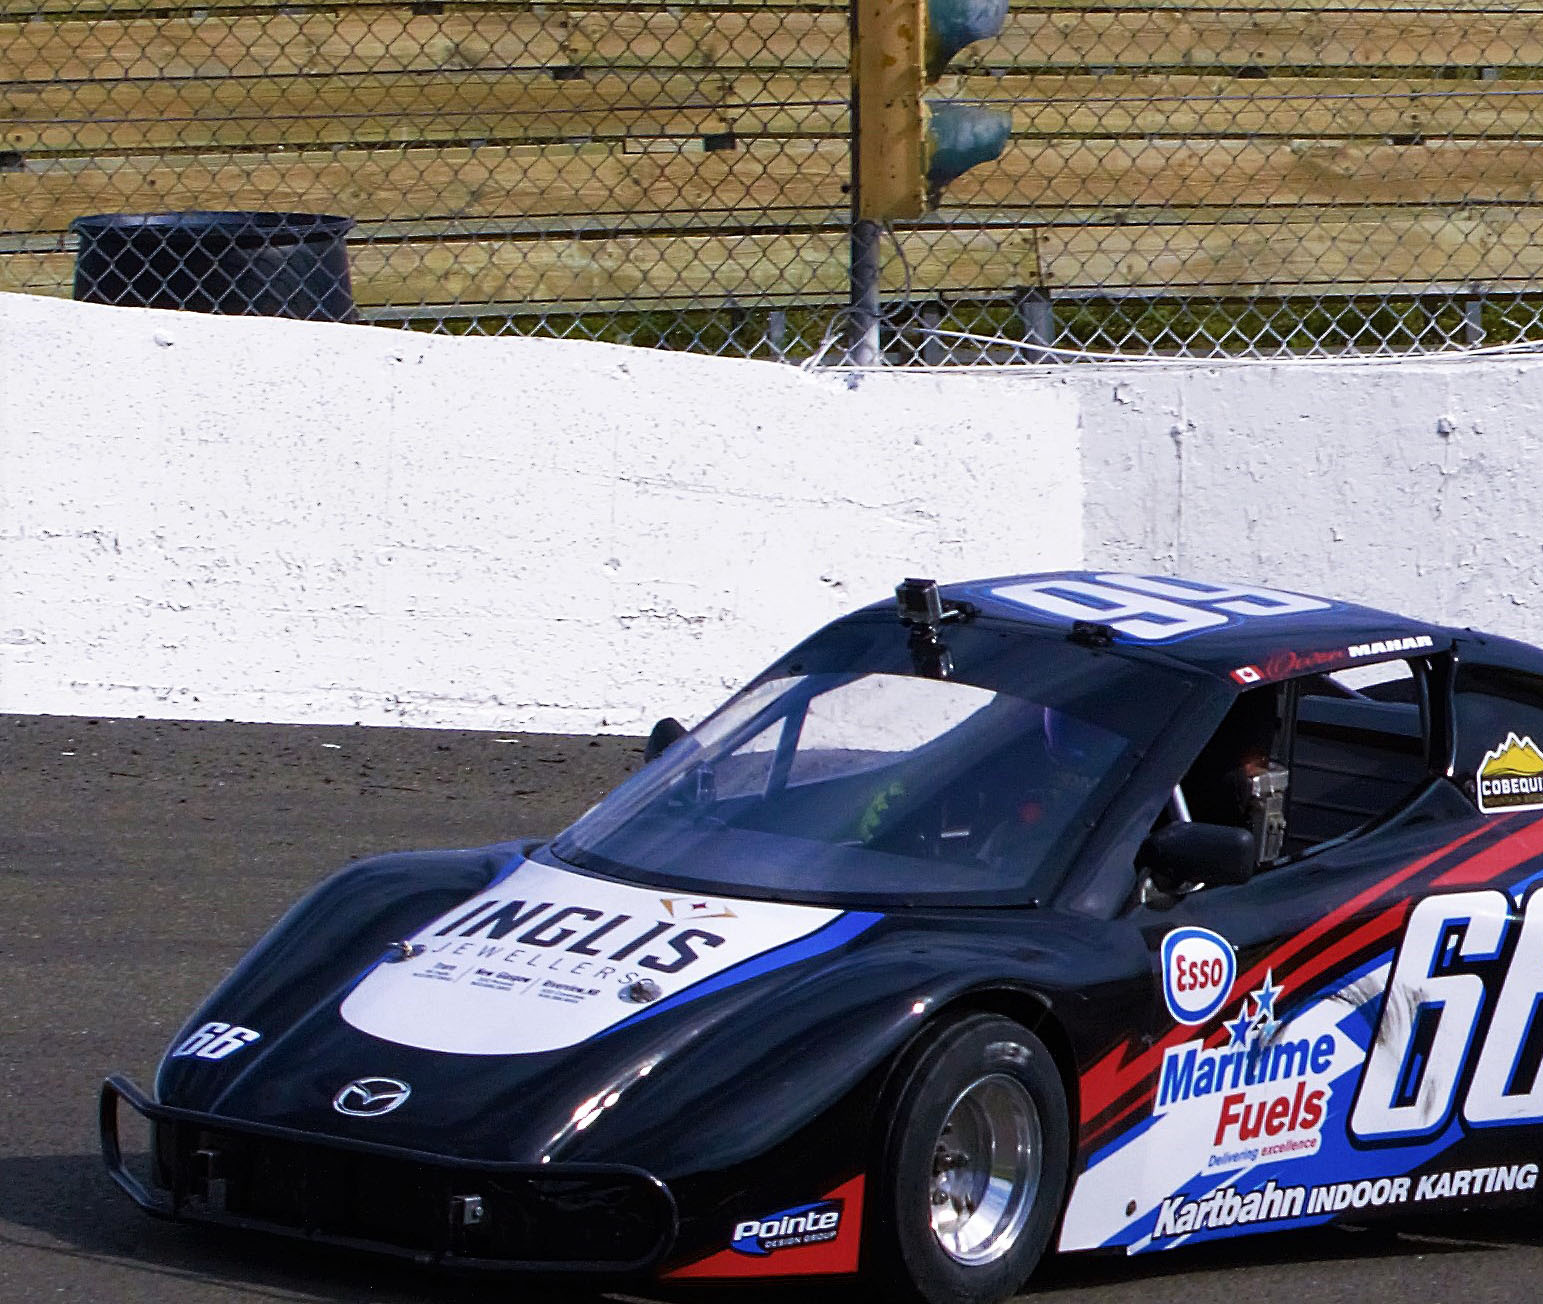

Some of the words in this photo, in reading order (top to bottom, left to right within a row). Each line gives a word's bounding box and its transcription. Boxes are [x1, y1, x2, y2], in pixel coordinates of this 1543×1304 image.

[1348, 635, 1433, 658] MAHAR
[434, 899, 726, 974] INGLIS
[433, 942, 641, 986] JEWELLERS
[1176, 954, 1224, 992] Esso
[172, 1022, 261, 1061] 66
[1159, 1034, 1336, 1107] Maritime
[1214, 1081, 1326, 1147] Fuels
[1208, 1147, 1259, 1168] Delivering
[1260, 1137, 1318, 1157] excellence
[1152, 1180, 1307, 1240] Kartbahn
[1306, 1177, 1411, 1215] INDOOR
[1414, 1162, 1539, 1201] KARTING
[734, 1211, 839, 1241] Pointe
